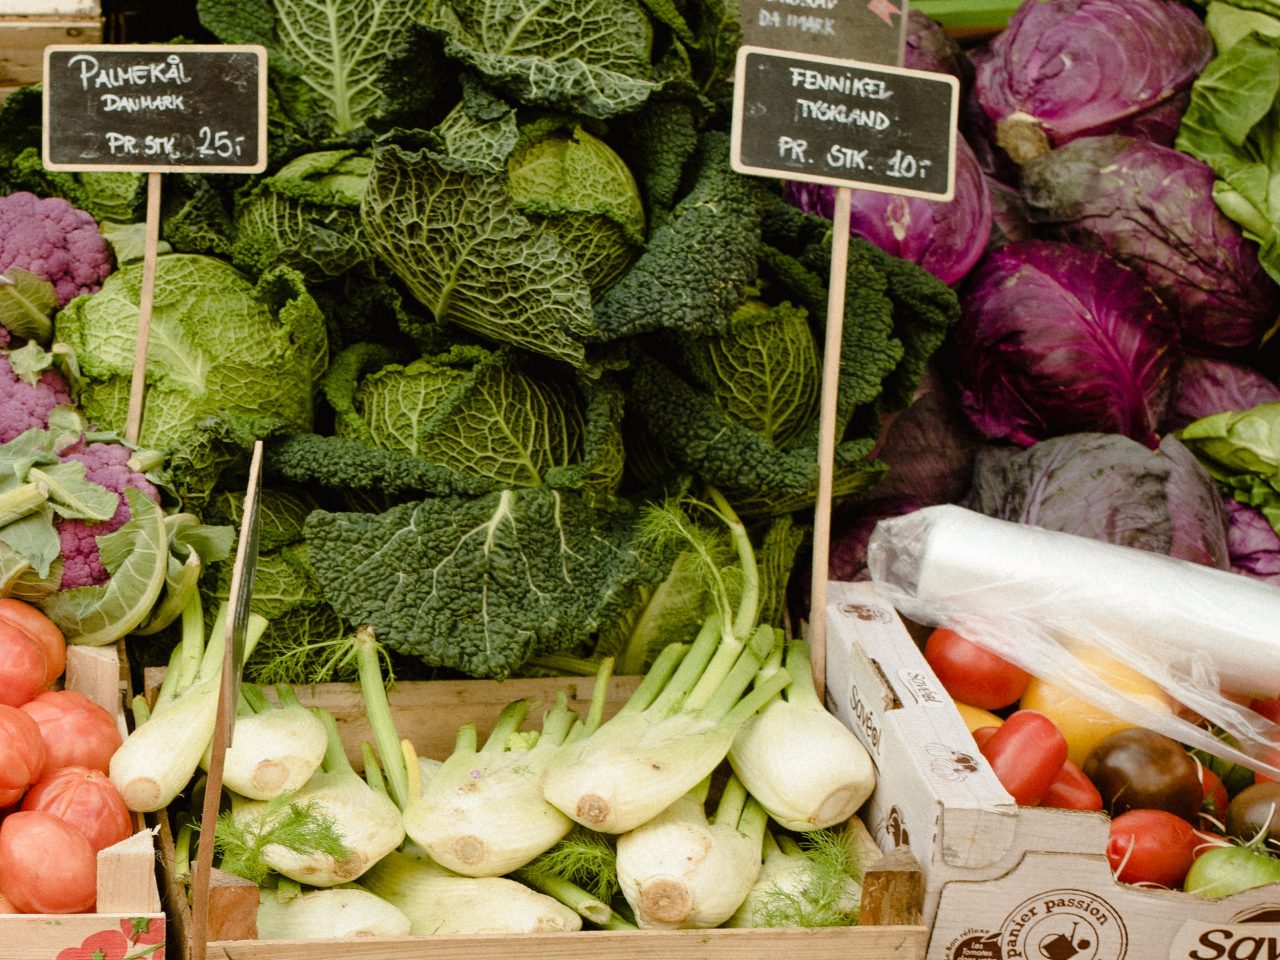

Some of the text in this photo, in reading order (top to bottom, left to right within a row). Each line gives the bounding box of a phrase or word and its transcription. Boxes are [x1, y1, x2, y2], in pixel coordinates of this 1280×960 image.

[68, 55, 192, 90] PALMEKÅL
[101, 94, 185, 113] DANMARK
[796, 98, 891, 131] TYSKLAND
[778, 136, 815, 164] PR.
[826, 144, 874, 171] STK.
[1007, 898, 1109, 960] panier passion
